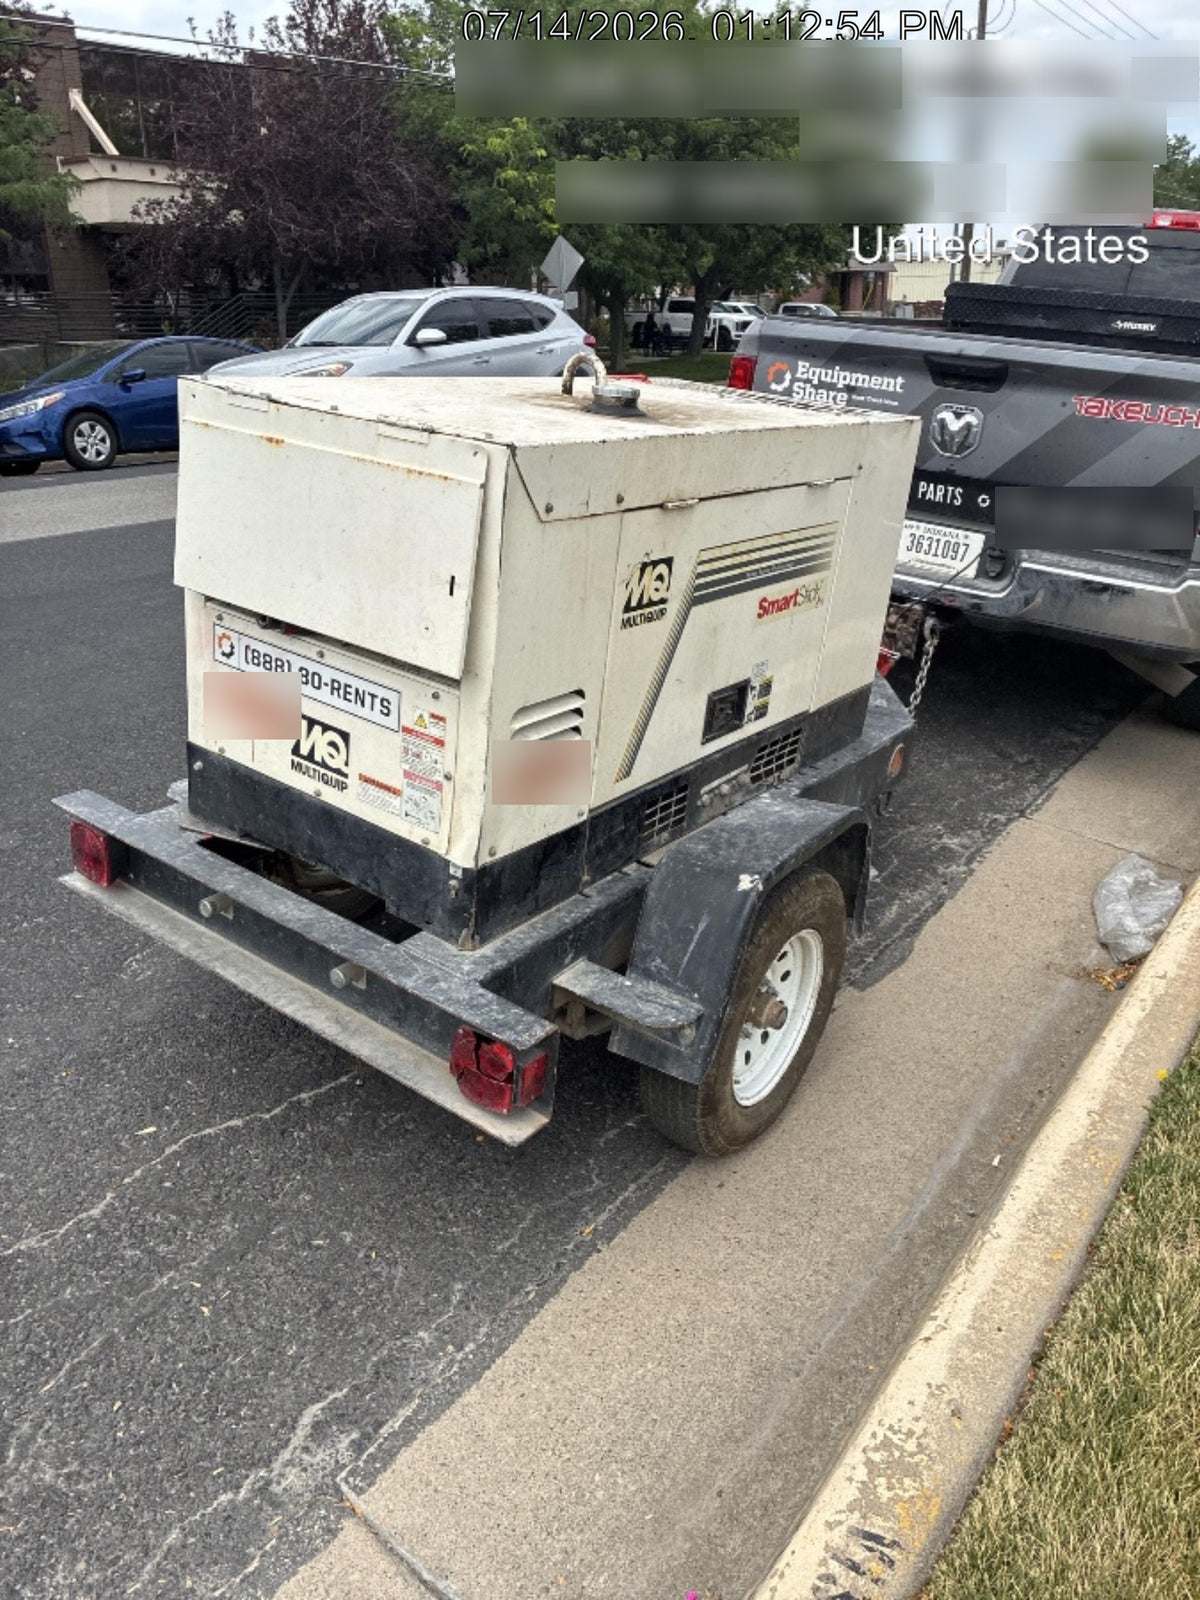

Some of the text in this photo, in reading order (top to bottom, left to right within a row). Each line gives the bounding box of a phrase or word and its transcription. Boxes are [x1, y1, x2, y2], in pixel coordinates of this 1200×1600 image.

[796, 360, 905, 393] Equipment
[792, 381, 849, 406] Share
[918, 481, 963, 506] PARTS
[906, 532, 970, 562] 3631097
[620, 607, 667, 630] MULTIQUIP
[244, 644, 292, 673] (888)
[290, 758, 349, 793] MULTIQUIP
